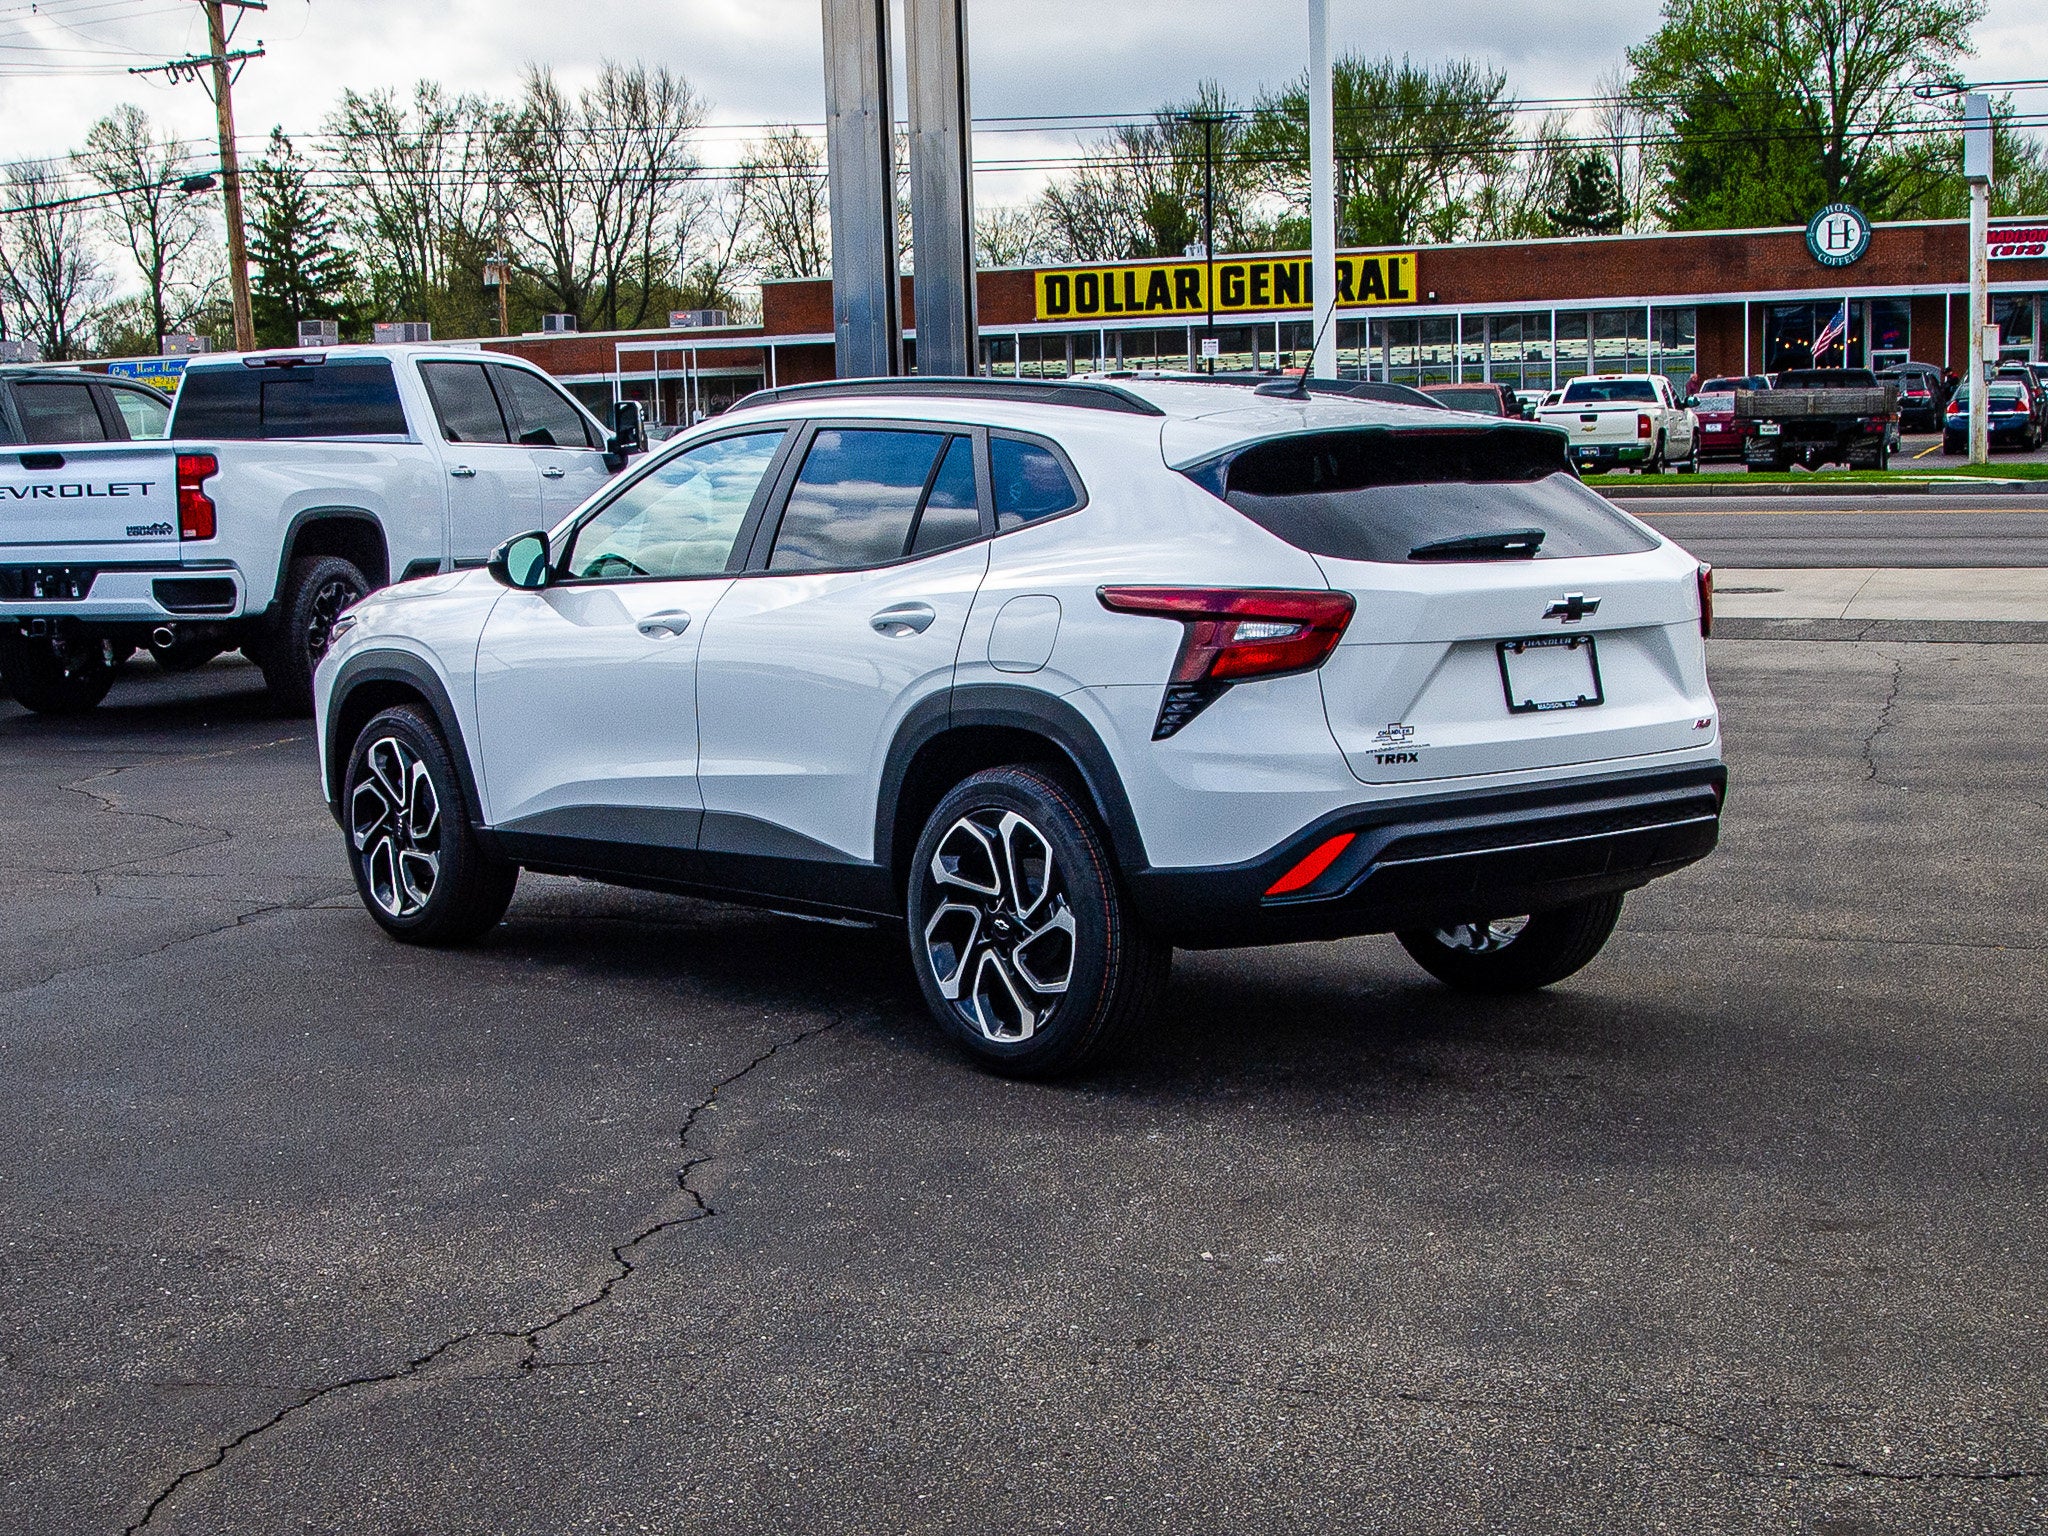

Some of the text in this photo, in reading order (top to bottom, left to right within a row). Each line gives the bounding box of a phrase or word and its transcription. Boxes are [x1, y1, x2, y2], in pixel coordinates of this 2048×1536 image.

[1826, 203, 1850, 214] HOS
[1987, 228, 2048, 244] MADISON
[1818, 252, 1857, 266] COFFEE
[1044, 268, 1202, 315] DOLLAR
[0, 482, 155, 499] VROLET
[1523, 637, 1571, 647] CHANDLER
[1374, 752, 1419, 764] TRAX
